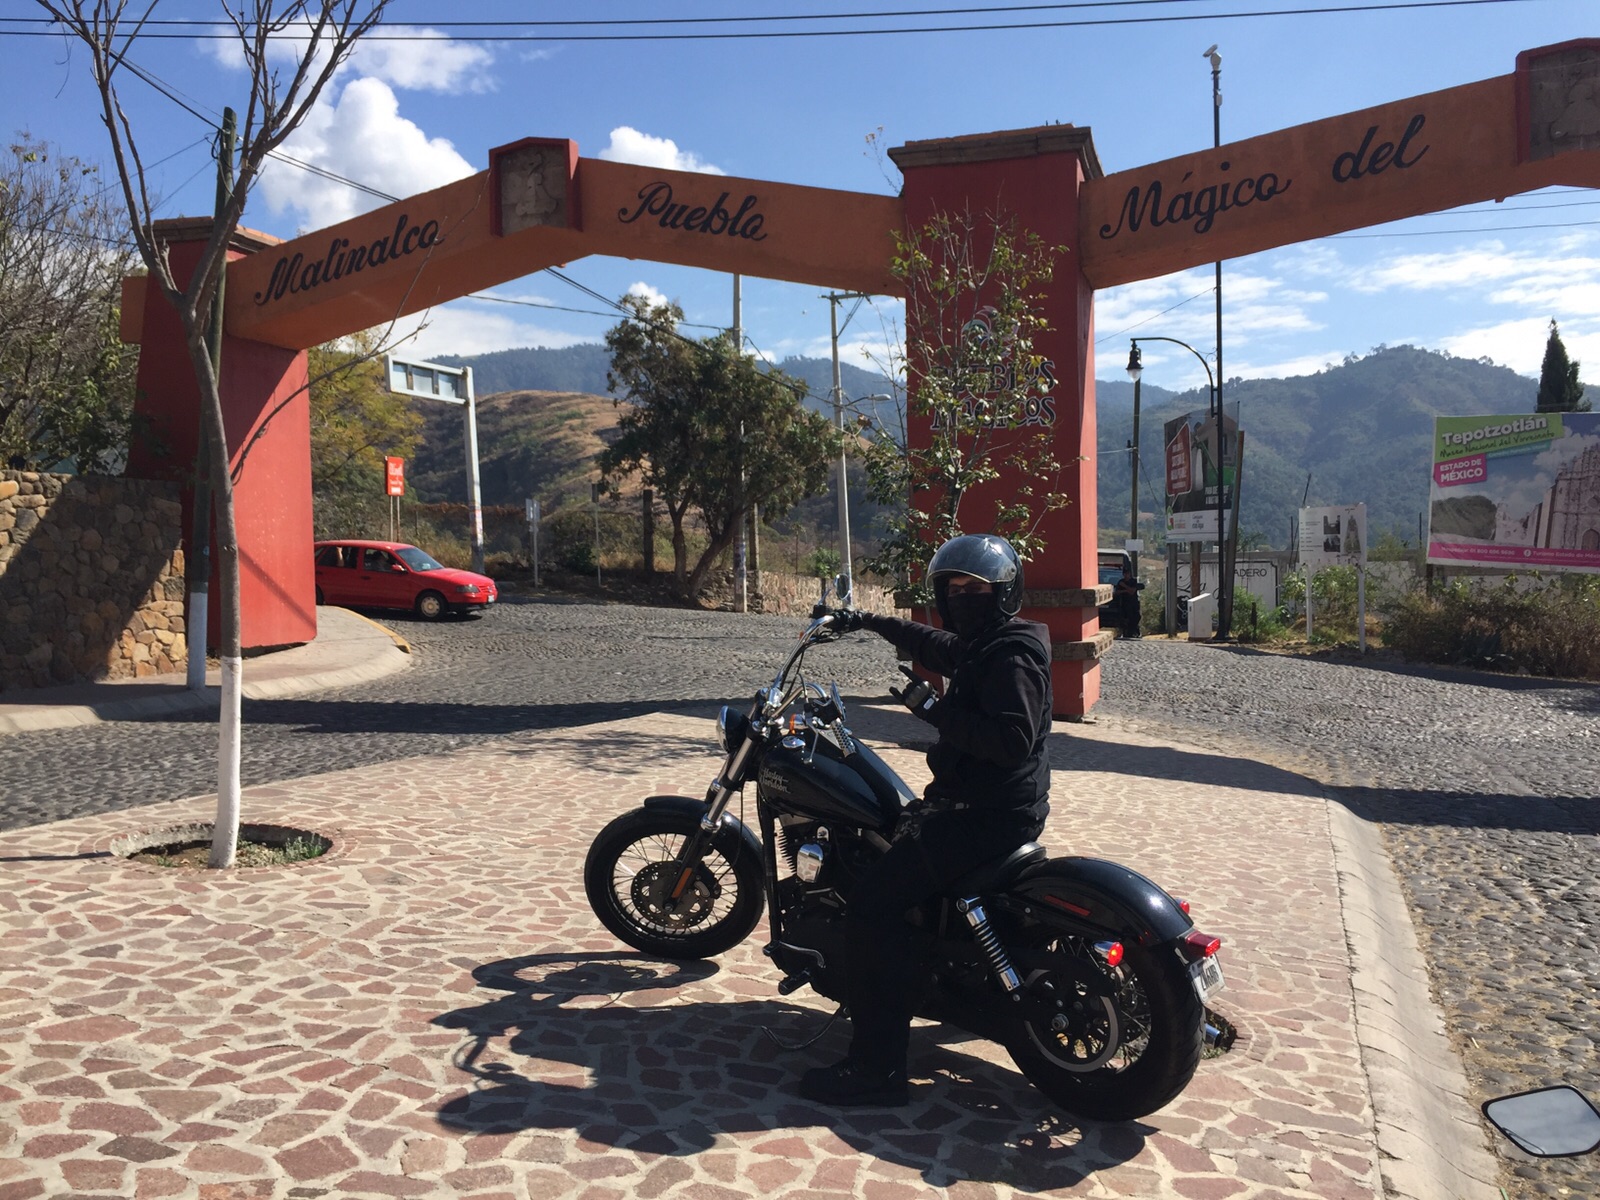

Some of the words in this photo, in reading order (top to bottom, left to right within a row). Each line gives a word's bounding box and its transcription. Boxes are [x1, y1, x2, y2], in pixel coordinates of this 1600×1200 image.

[255, 213, 445, 306] Malinalco
[618, 181, 768, 242] Pueblo
[1100, 161, 1292, 239] Mágico
[1332, 114, 1430, 183] del
[1442, 416, 1547, 446] Tepotzotlán
[1465, 440, 1497, 453] Nacional
[1499, 436, 1511, 447] del
[1440, 460, 1470, 472] ESTADO
[1471, 458, 1482, 467] DE
[1440, 467, 1483, 483] MÉXICO
